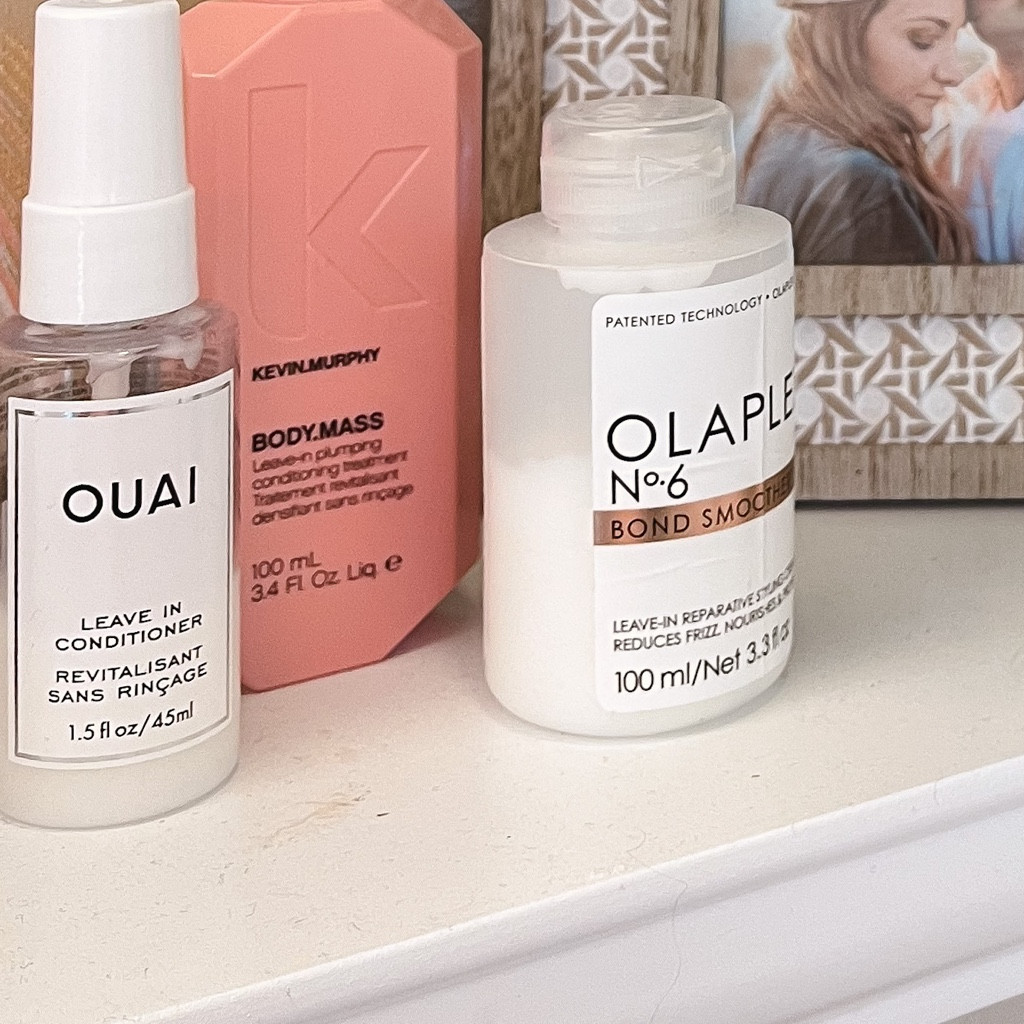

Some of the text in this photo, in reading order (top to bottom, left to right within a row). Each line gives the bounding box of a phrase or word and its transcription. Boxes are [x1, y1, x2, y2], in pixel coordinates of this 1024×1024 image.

[605, 313, 676, 328] PATENTED
[681, 294, 763, 323] TECHNOLOGY
[251, 411, 384, 453] BODY.MASS
[62, 465, 198, 523] OUAI
[611, 513, 690, 540] BOND
[253, 552, 321, 579] 100 mL
[55, 614, 202, 651] CONDITIONER
[81, 601, 182, 631] LEAVE IN
[613, 613, 678, 633] LEAVE-IN
[613, 632, 682, 652] REDUCES
[56, 644, 203, 684] REVITALISANT
[615, 668, 654, 693] 100
[660, 647, 741, 689] ml/Net
[48, 662, 208, 704] SANS RINÇAGE
[69, 723, 95, 741] 1.5
